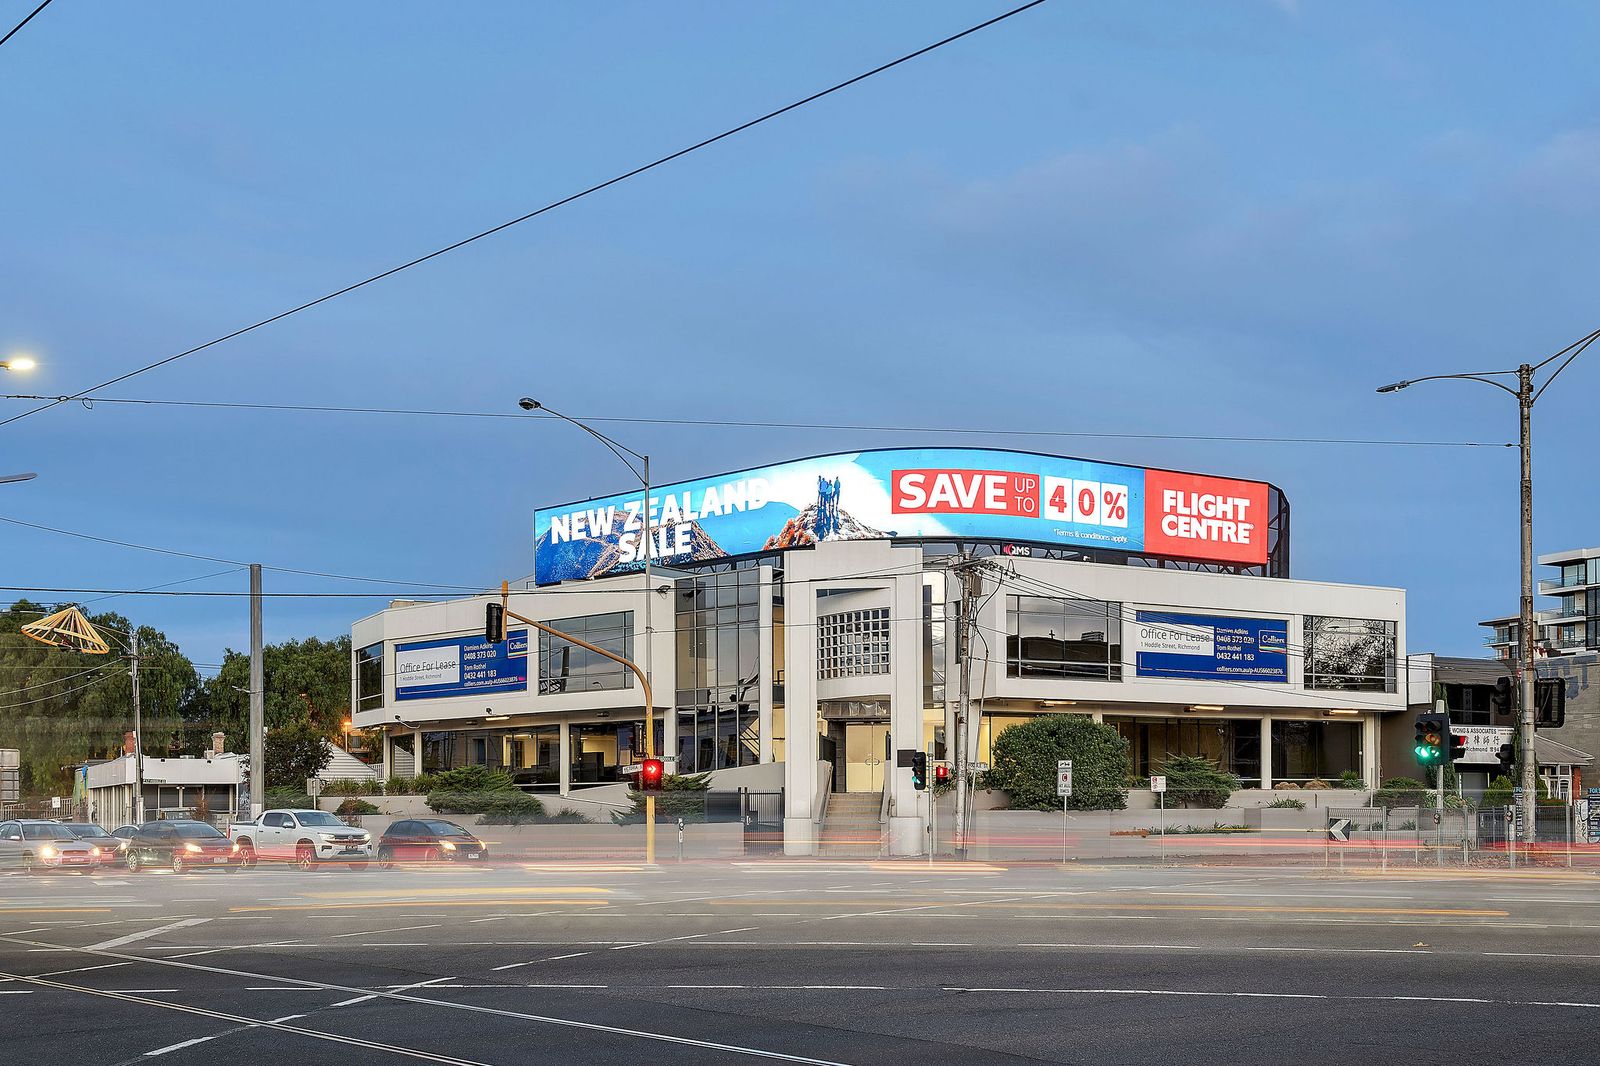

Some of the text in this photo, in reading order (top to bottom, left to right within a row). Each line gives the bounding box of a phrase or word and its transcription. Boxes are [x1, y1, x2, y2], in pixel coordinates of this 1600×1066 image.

[899, 473, 1008, 510] SAVE
[1014, 477, 1036, 494] UP
[551, 478, 769, 544] NEW ZEALAND
[1014, 496, 1036, 513] TO
[1163, 489, 1251, 520] FLIGHT
[1081, 533, 1110, 541] conditions
[1161, 514, 1250, 544] CENTRE
[618, 523, 692, 563] SALE
[1140, 628, 1210, 643] Office For Lease
[1261, 635, 1285, 644] Colliers
[1216, 652, 1231, 660] 0432
[1243, 653, 1255, 661] 183
[400, 660, 456, 674] Office For Lease
[463, 669, 497, 680] 0432 441 183
